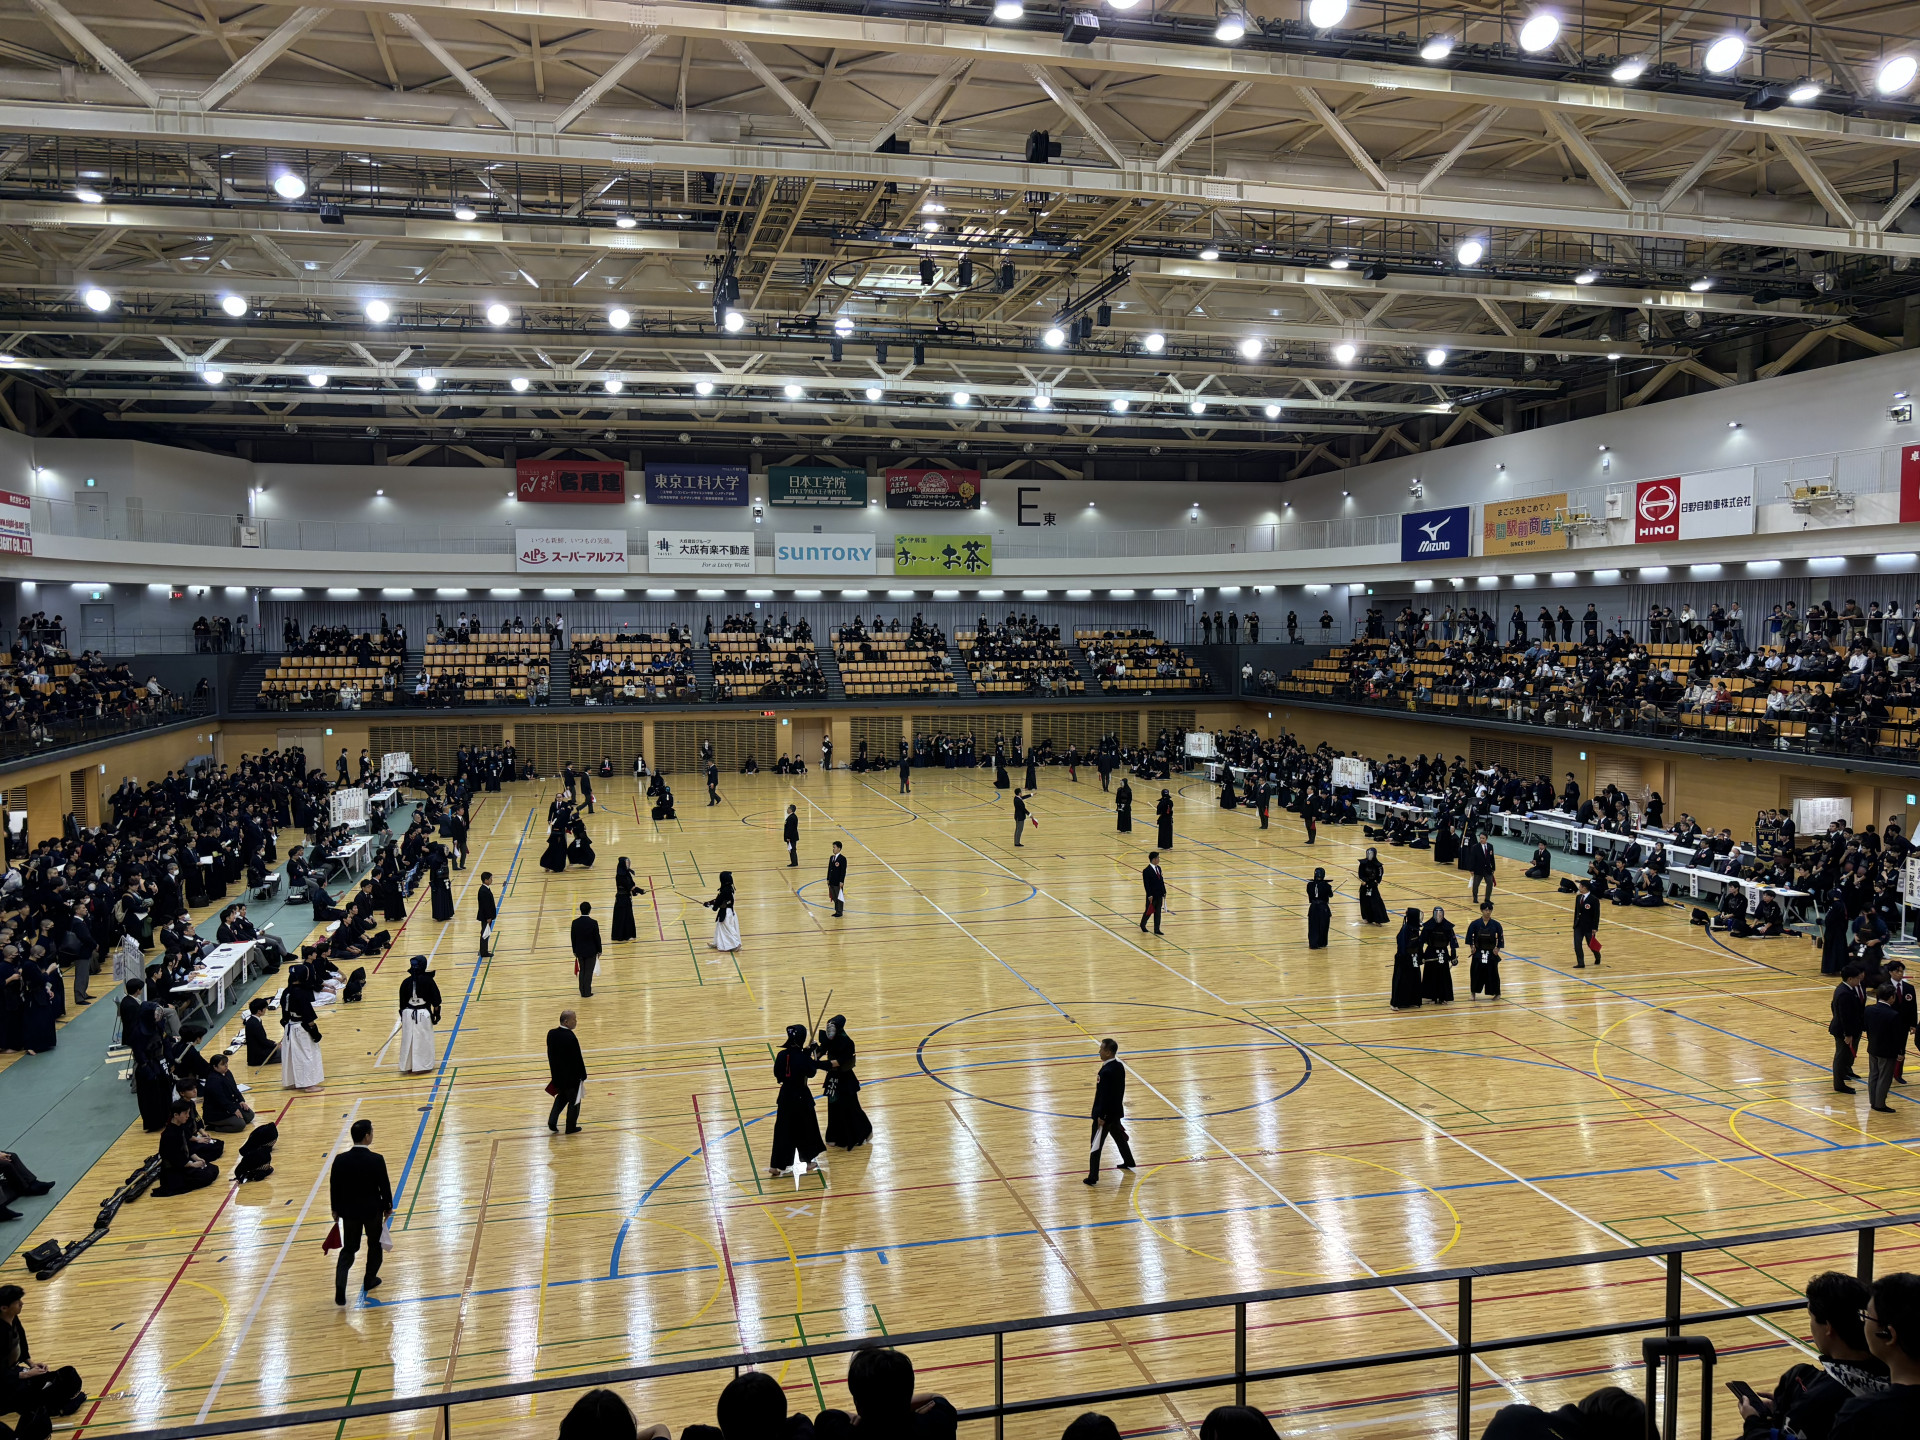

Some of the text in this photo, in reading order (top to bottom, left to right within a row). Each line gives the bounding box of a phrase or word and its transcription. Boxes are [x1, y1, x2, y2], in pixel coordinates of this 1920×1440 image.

[654, 474, 740, 491] 東京工科大学
[789, 475, 847, 489] 日本工学院
[906, 499, 961, 507] 八王子ビートレインズ
[1017, 487, 1041, 526] E
[1681, 495, 1751, 513] 日野自動車株式会社
[1043, 512, 1056, 526] 東
[1639, 525, 1675, 536] HINO
[523, 548, 546, 561] ALPS
[552, 551, 625, 562] スーパーアルプス
[679, 544, 750, 556] 大成有楽不動産
[778, 546, 872, 561] SUNTORY
